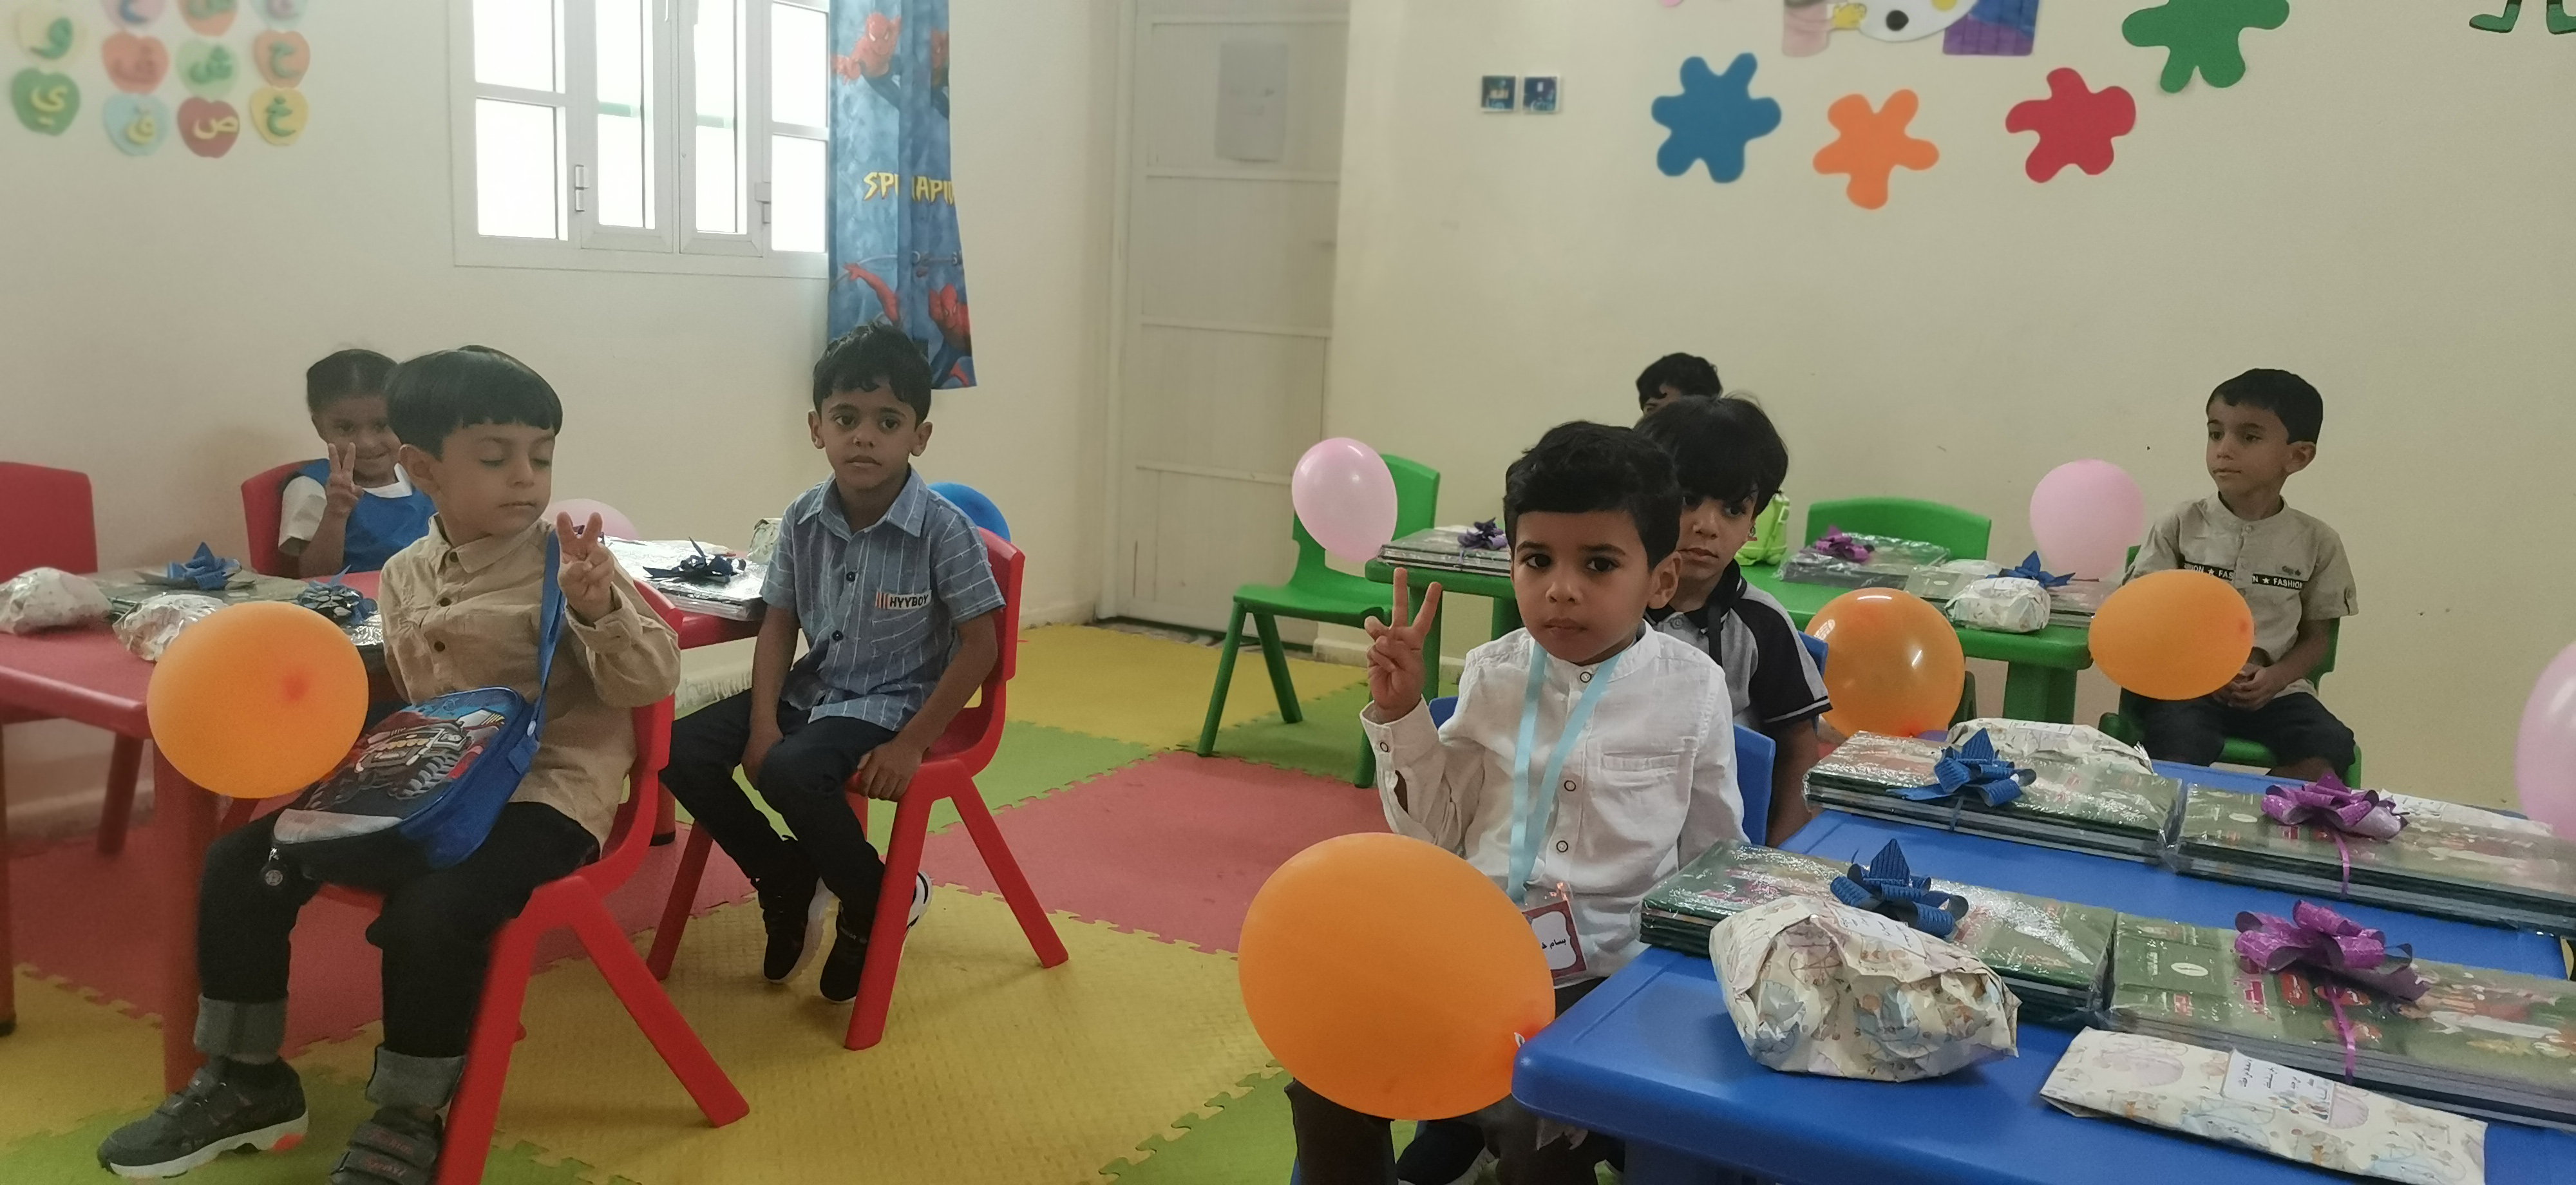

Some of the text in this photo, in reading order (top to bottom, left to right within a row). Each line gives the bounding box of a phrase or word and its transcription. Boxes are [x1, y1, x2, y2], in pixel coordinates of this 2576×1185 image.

[31, 86, 68, 126] ي
[193, 116, 239, 140] ص
[889, 594, 929, 608] HYYBOY
